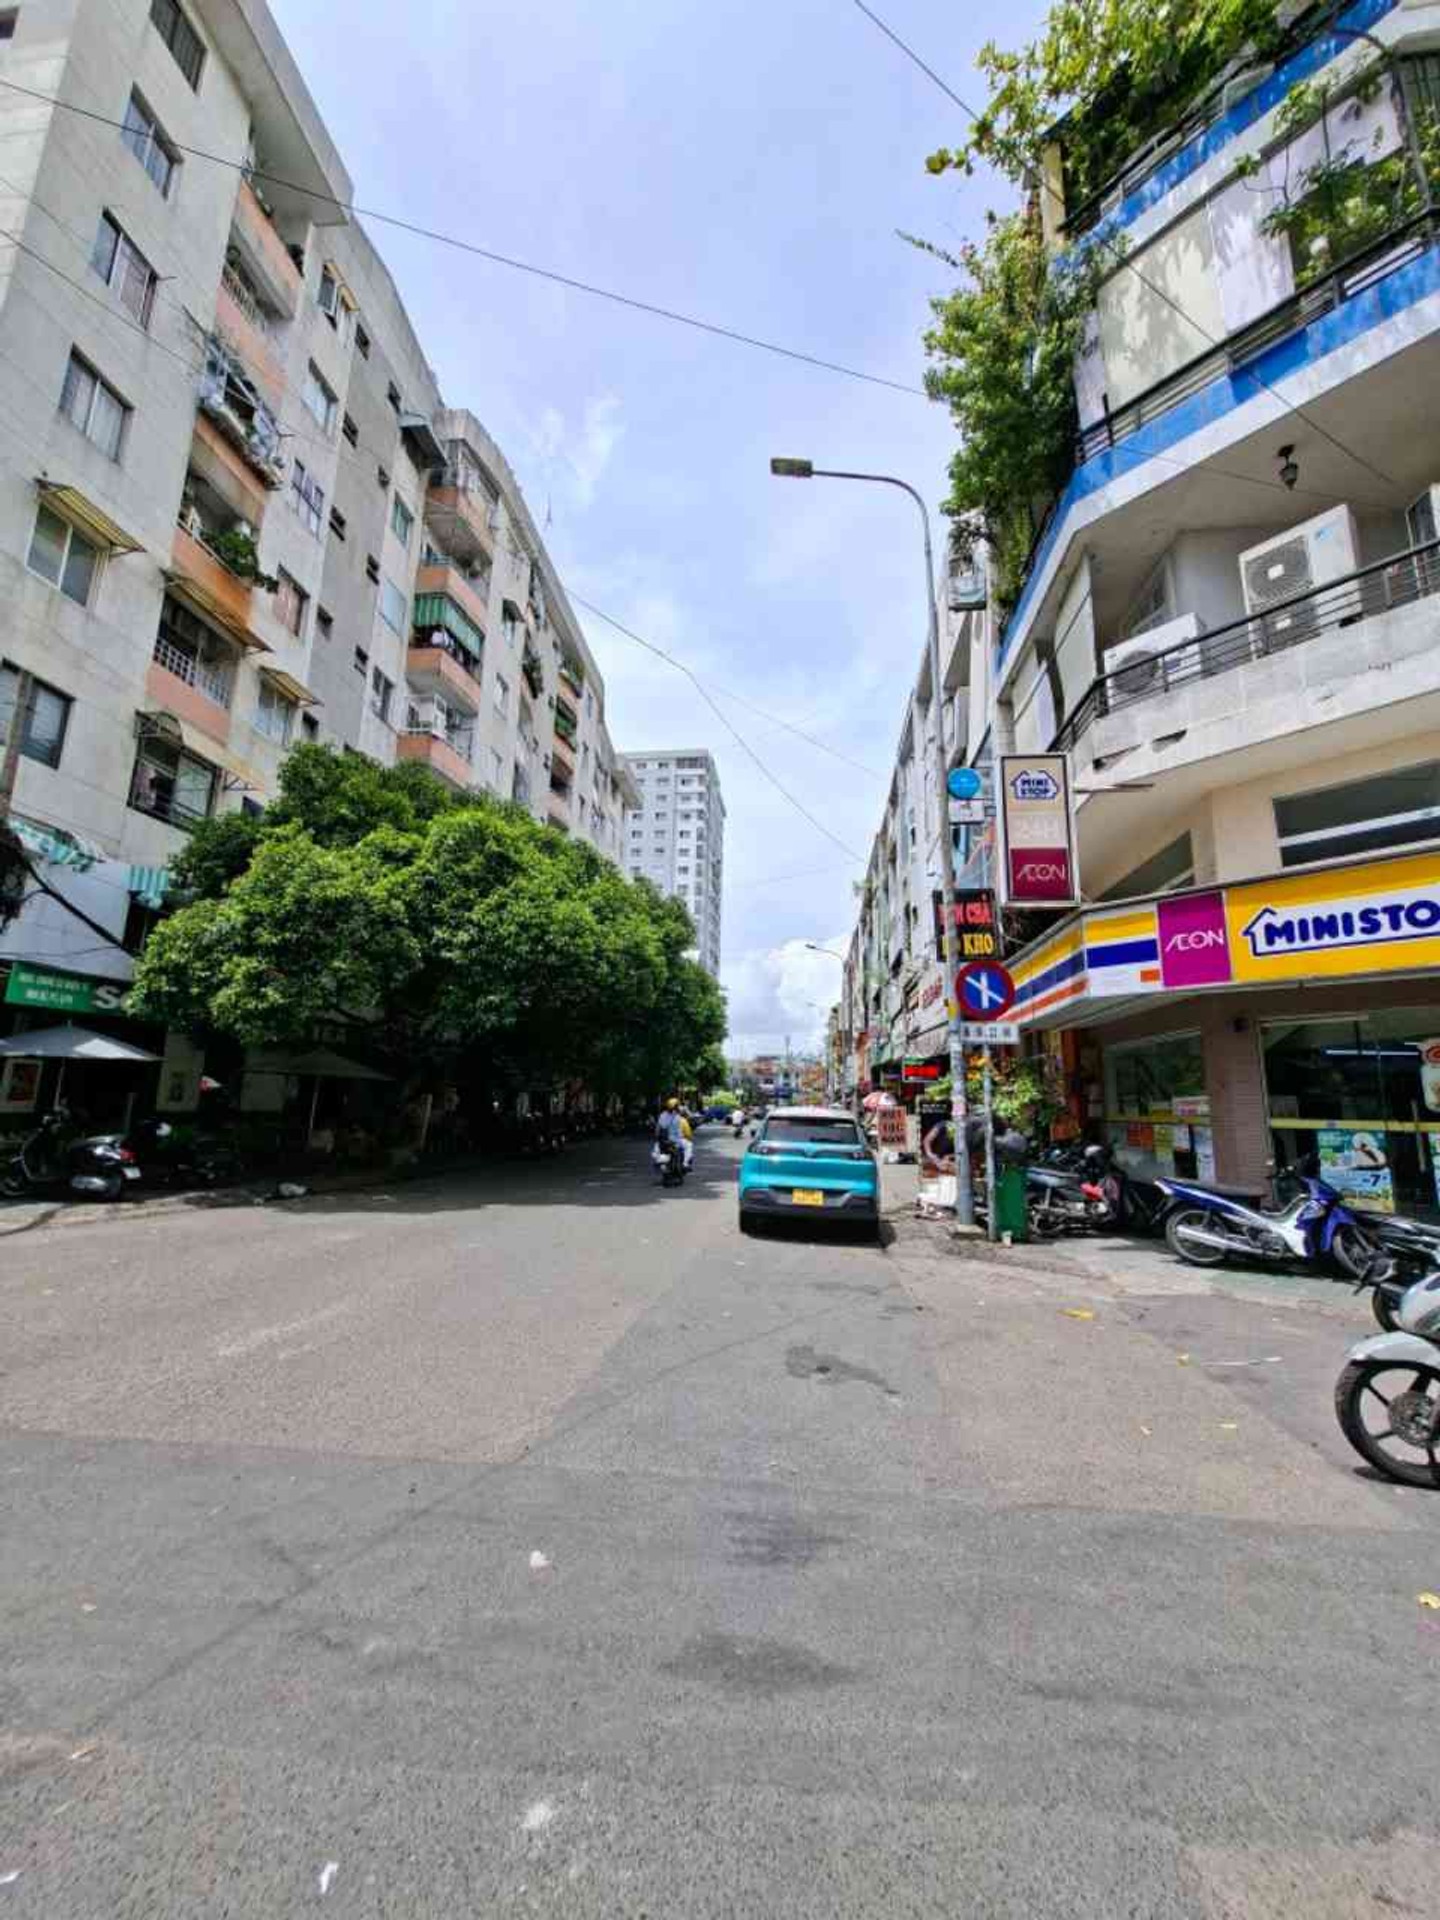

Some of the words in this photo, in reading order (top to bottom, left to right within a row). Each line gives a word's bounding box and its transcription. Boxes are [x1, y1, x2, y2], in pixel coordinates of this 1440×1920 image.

[1020, 778, 1049, 787] MINI
[1020, 787, 1050, 796] STOP
[962, 933, 994, 956] KHO
